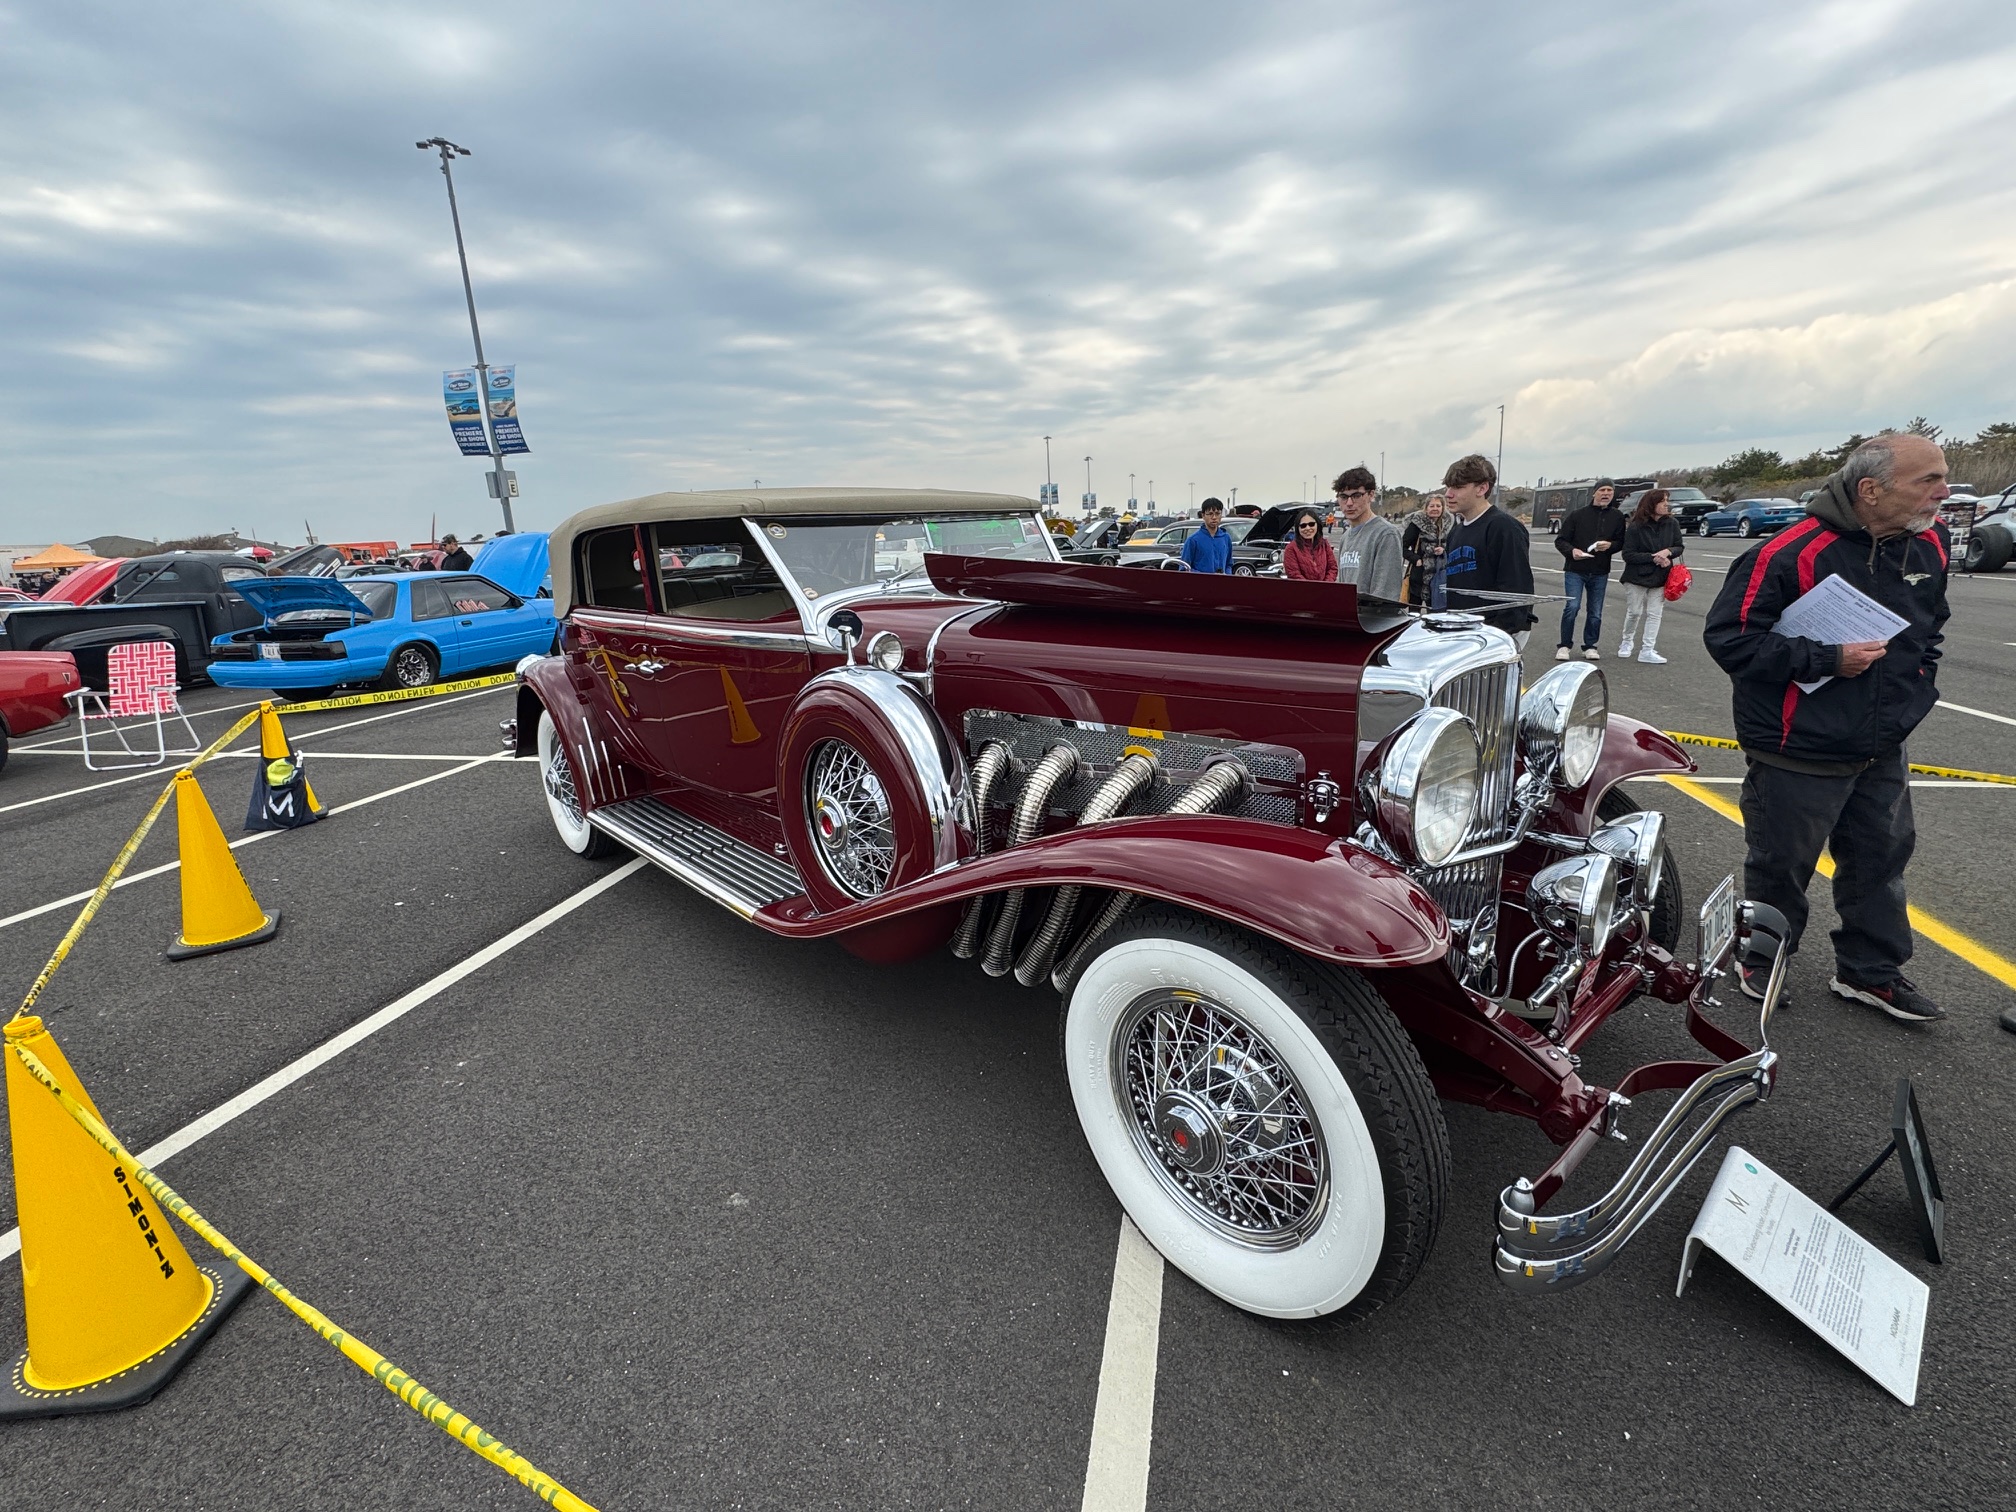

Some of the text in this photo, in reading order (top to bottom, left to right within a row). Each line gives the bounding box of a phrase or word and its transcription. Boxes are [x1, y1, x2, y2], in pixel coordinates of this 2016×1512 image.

[511, 484, 516, 493] E
[262, 791, 295, 819] M
[1725, 1188, 1750, 1214] M
[114, 1166, 175, 1279] SIMONIZ
